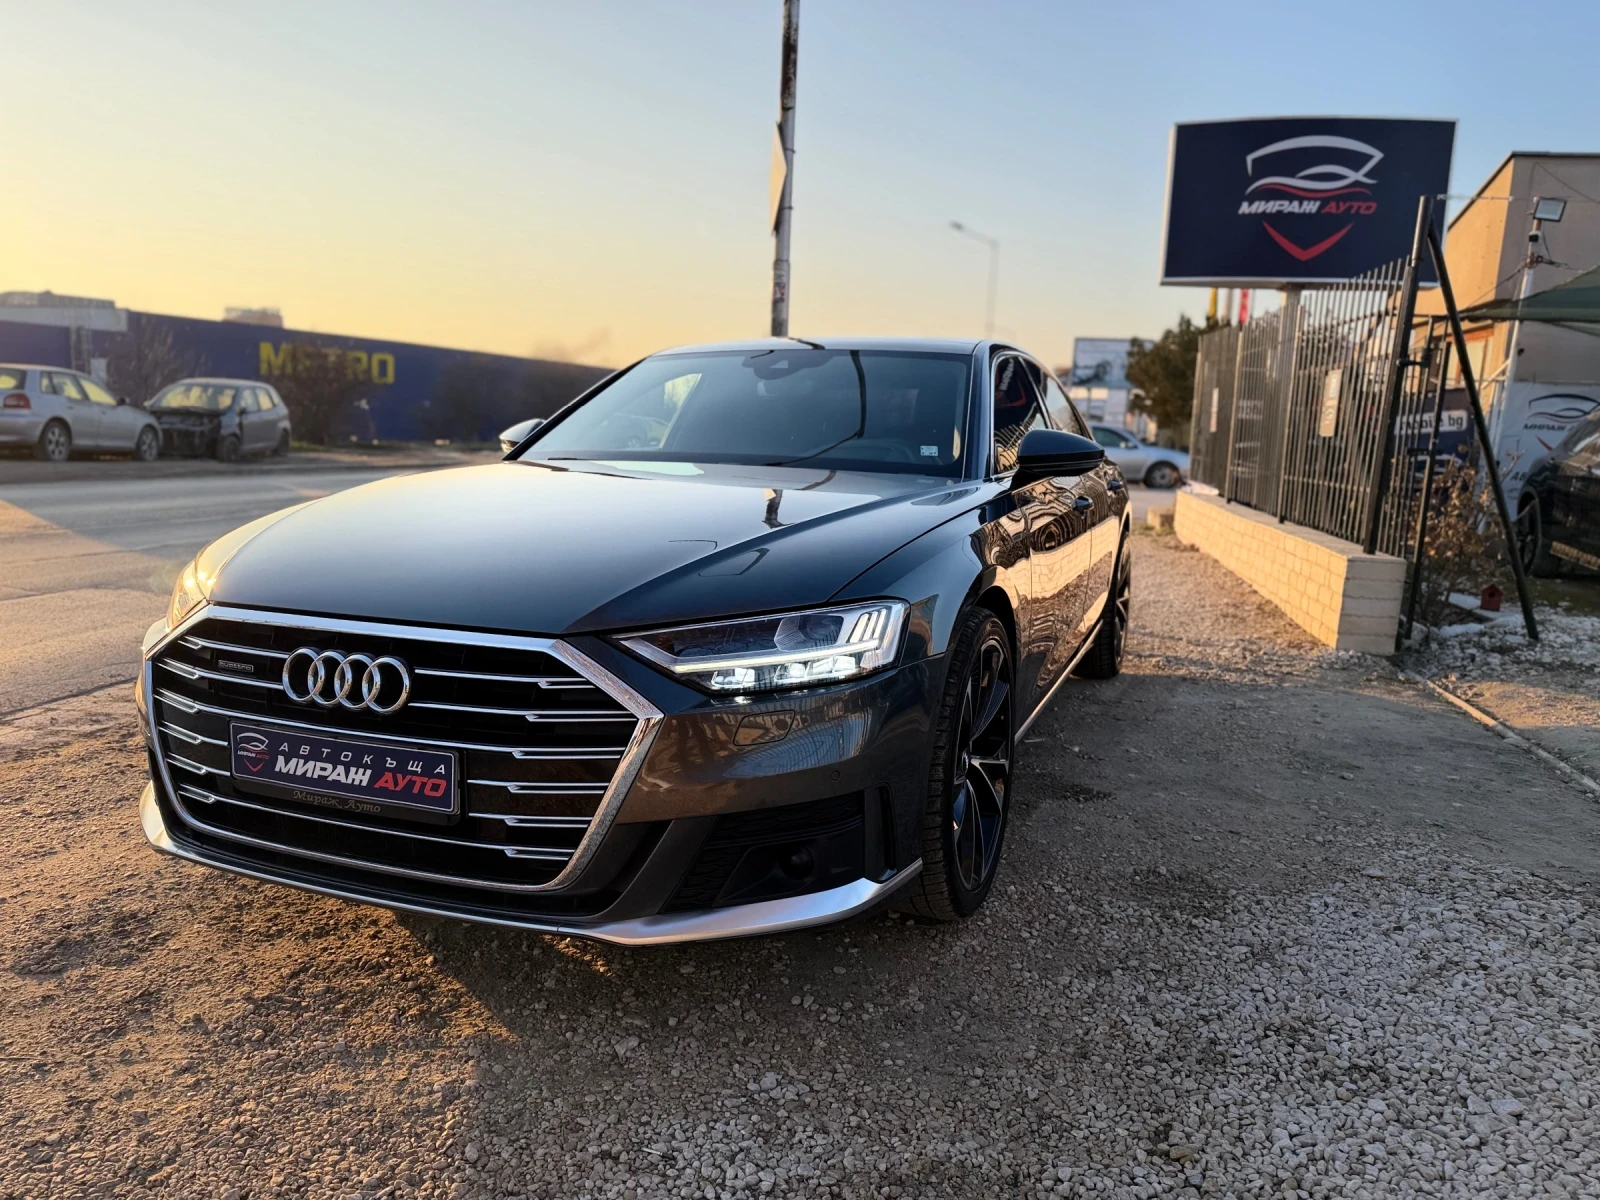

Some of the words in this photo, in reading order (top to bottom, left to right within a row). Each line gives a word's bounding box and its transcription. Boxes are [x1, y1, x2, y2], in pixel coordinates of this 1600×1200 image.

[1238, 200, 1321, 215] МИРАЖ
[1321, 202, 1377, 215] АУТО
[259, 341, 395, 384] METRO
[218, 661, 252, 671] quattro
[279, 742, 446, 775] АВТОКЪЩА
[274, 755, 373, 787] МИРАЖ
[373, 771, 447, 797] АУТО
[293, 790, 342, 808] Мираж
[344, 799, 381, 813] Ауто
